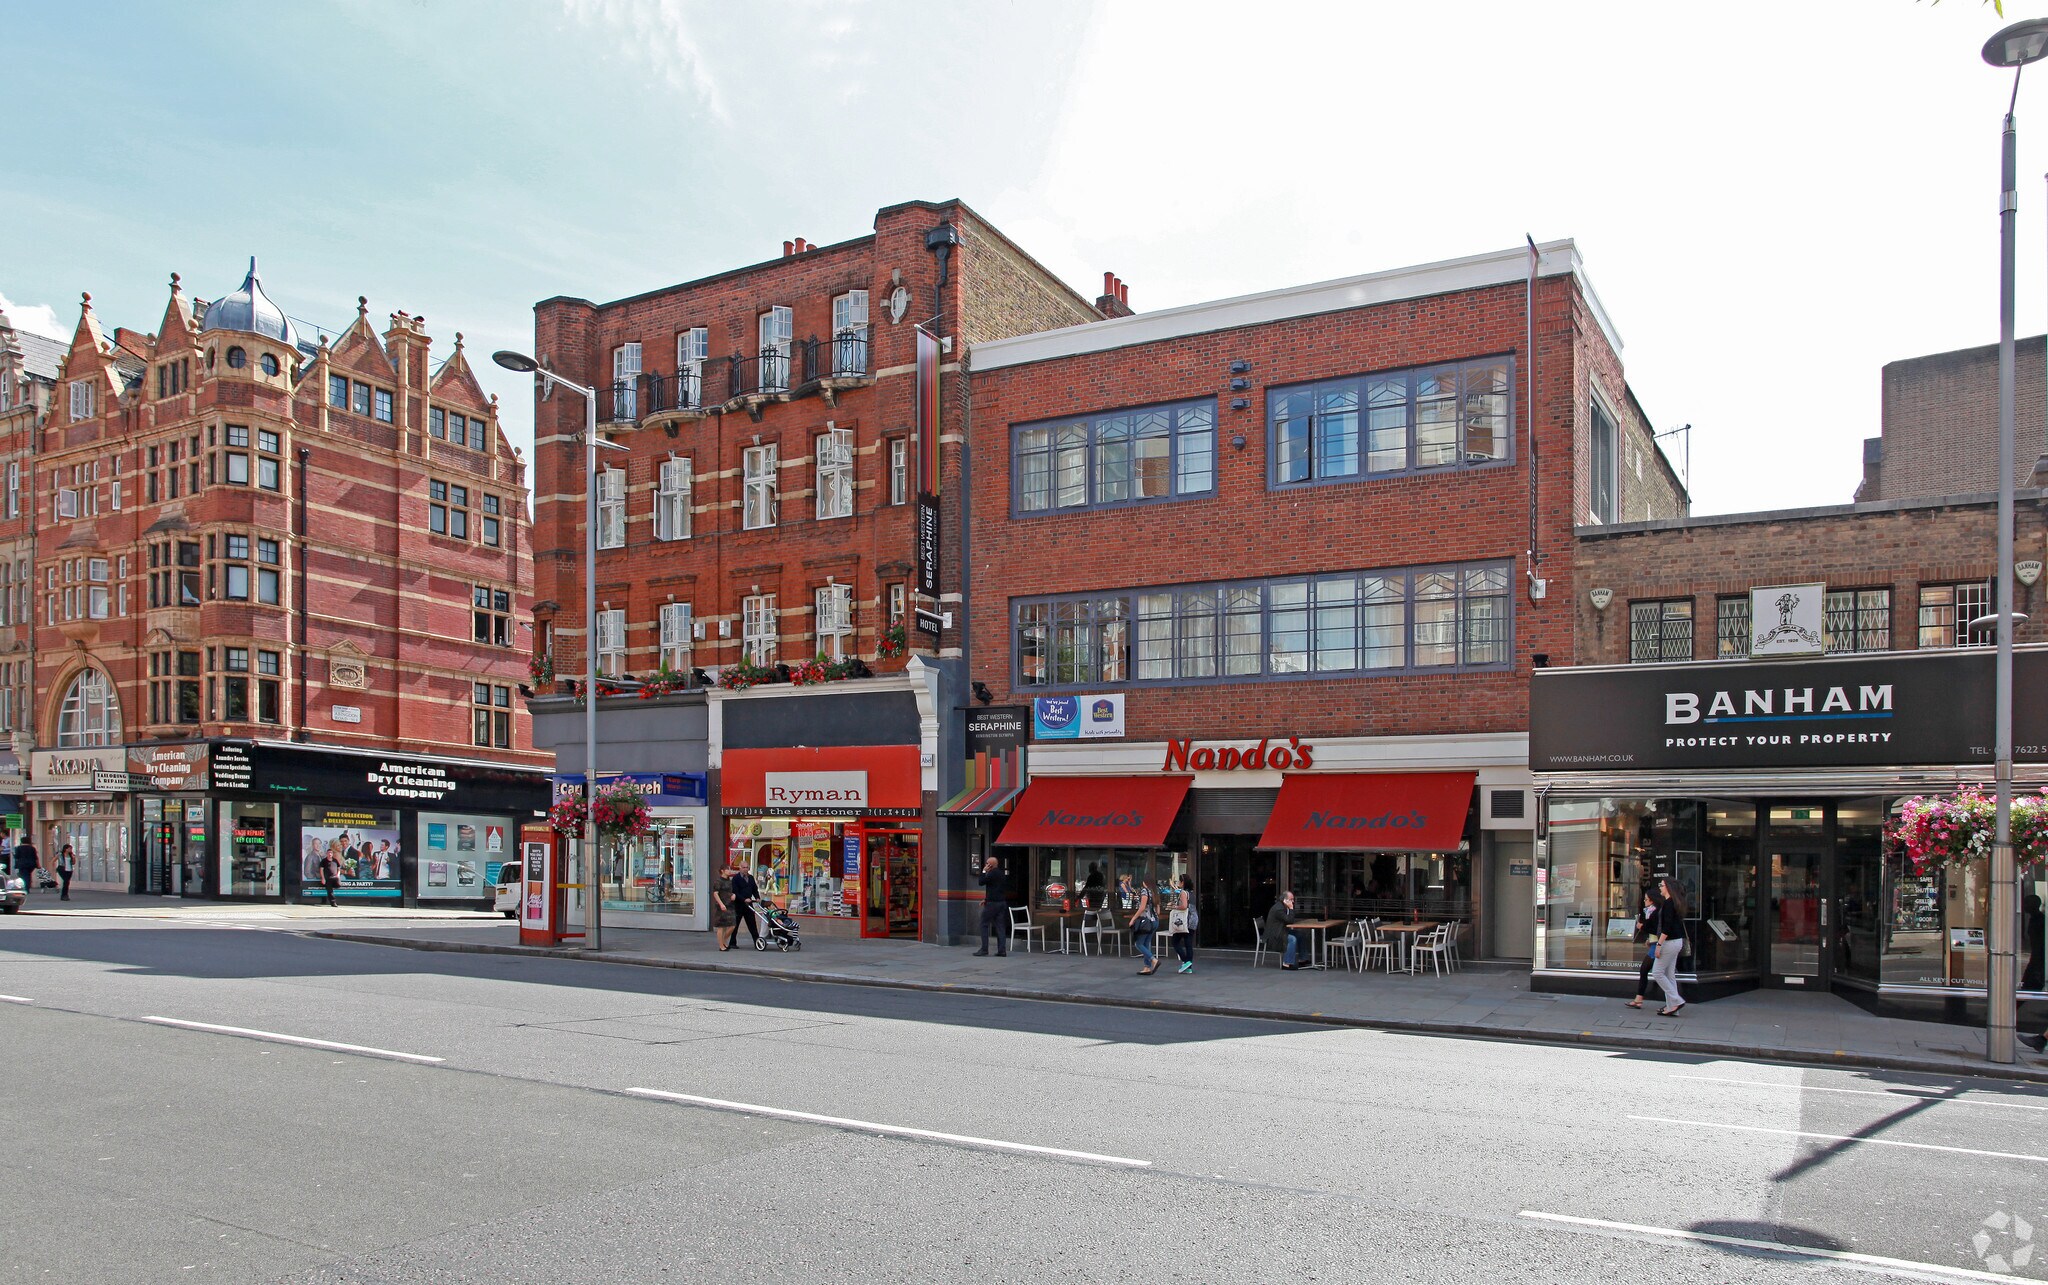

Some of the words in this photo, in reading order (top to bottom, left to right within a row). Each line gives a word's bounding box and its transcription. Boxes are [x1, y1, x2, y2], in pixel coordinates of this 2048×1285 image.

[925, 505, 933, 590] SERAPHINE
[919, 618, 939, 633] HOTEL
[1050, 704, 1063, 714] Best
[1664, 684, 1894, 725] BANHAM
[1042, 711, 1069, 722] Western!
[968, 721, 1022, 732] SERAPHINE
[1666, 737, 1738, 747] PROTECT
[1746, 735, 1792, 745] YOUR
[1800, 732, 1892, 744] PROPERTY
[151, 751, 186, 761] American
[1161, 735, 1313, 772] Nando's
[2014, 745, 2038, 754] 7622
[1549, 754, 1634, 763] WWW.BANHAM.CO.UK
[48, 757, 99, 775] AKKADIA
[146, 764, 159, 774] Dry
[159, 762, 191, 774] Cleaning
[379, 762, 446, 777] American
[151, 775, 185, 786] Company
[367, 772, 393, 785] Dry
[394, 773, 457, 791] Cleaning
[378, 785, 444, 800] Company
[768, 786, 862, 804] Ryman
[340, 811, 374, 820] COLLECTION
[769, 807, 791, 816] the
[796, 807, 862, 816] stationer
[1037, 809, 1146, 828] Nando's
[1301, 809, 1429, 830] Nando's
[246, 829, 265, 837] REPAIRS
[245, 837, 265, 845] CUTTING
